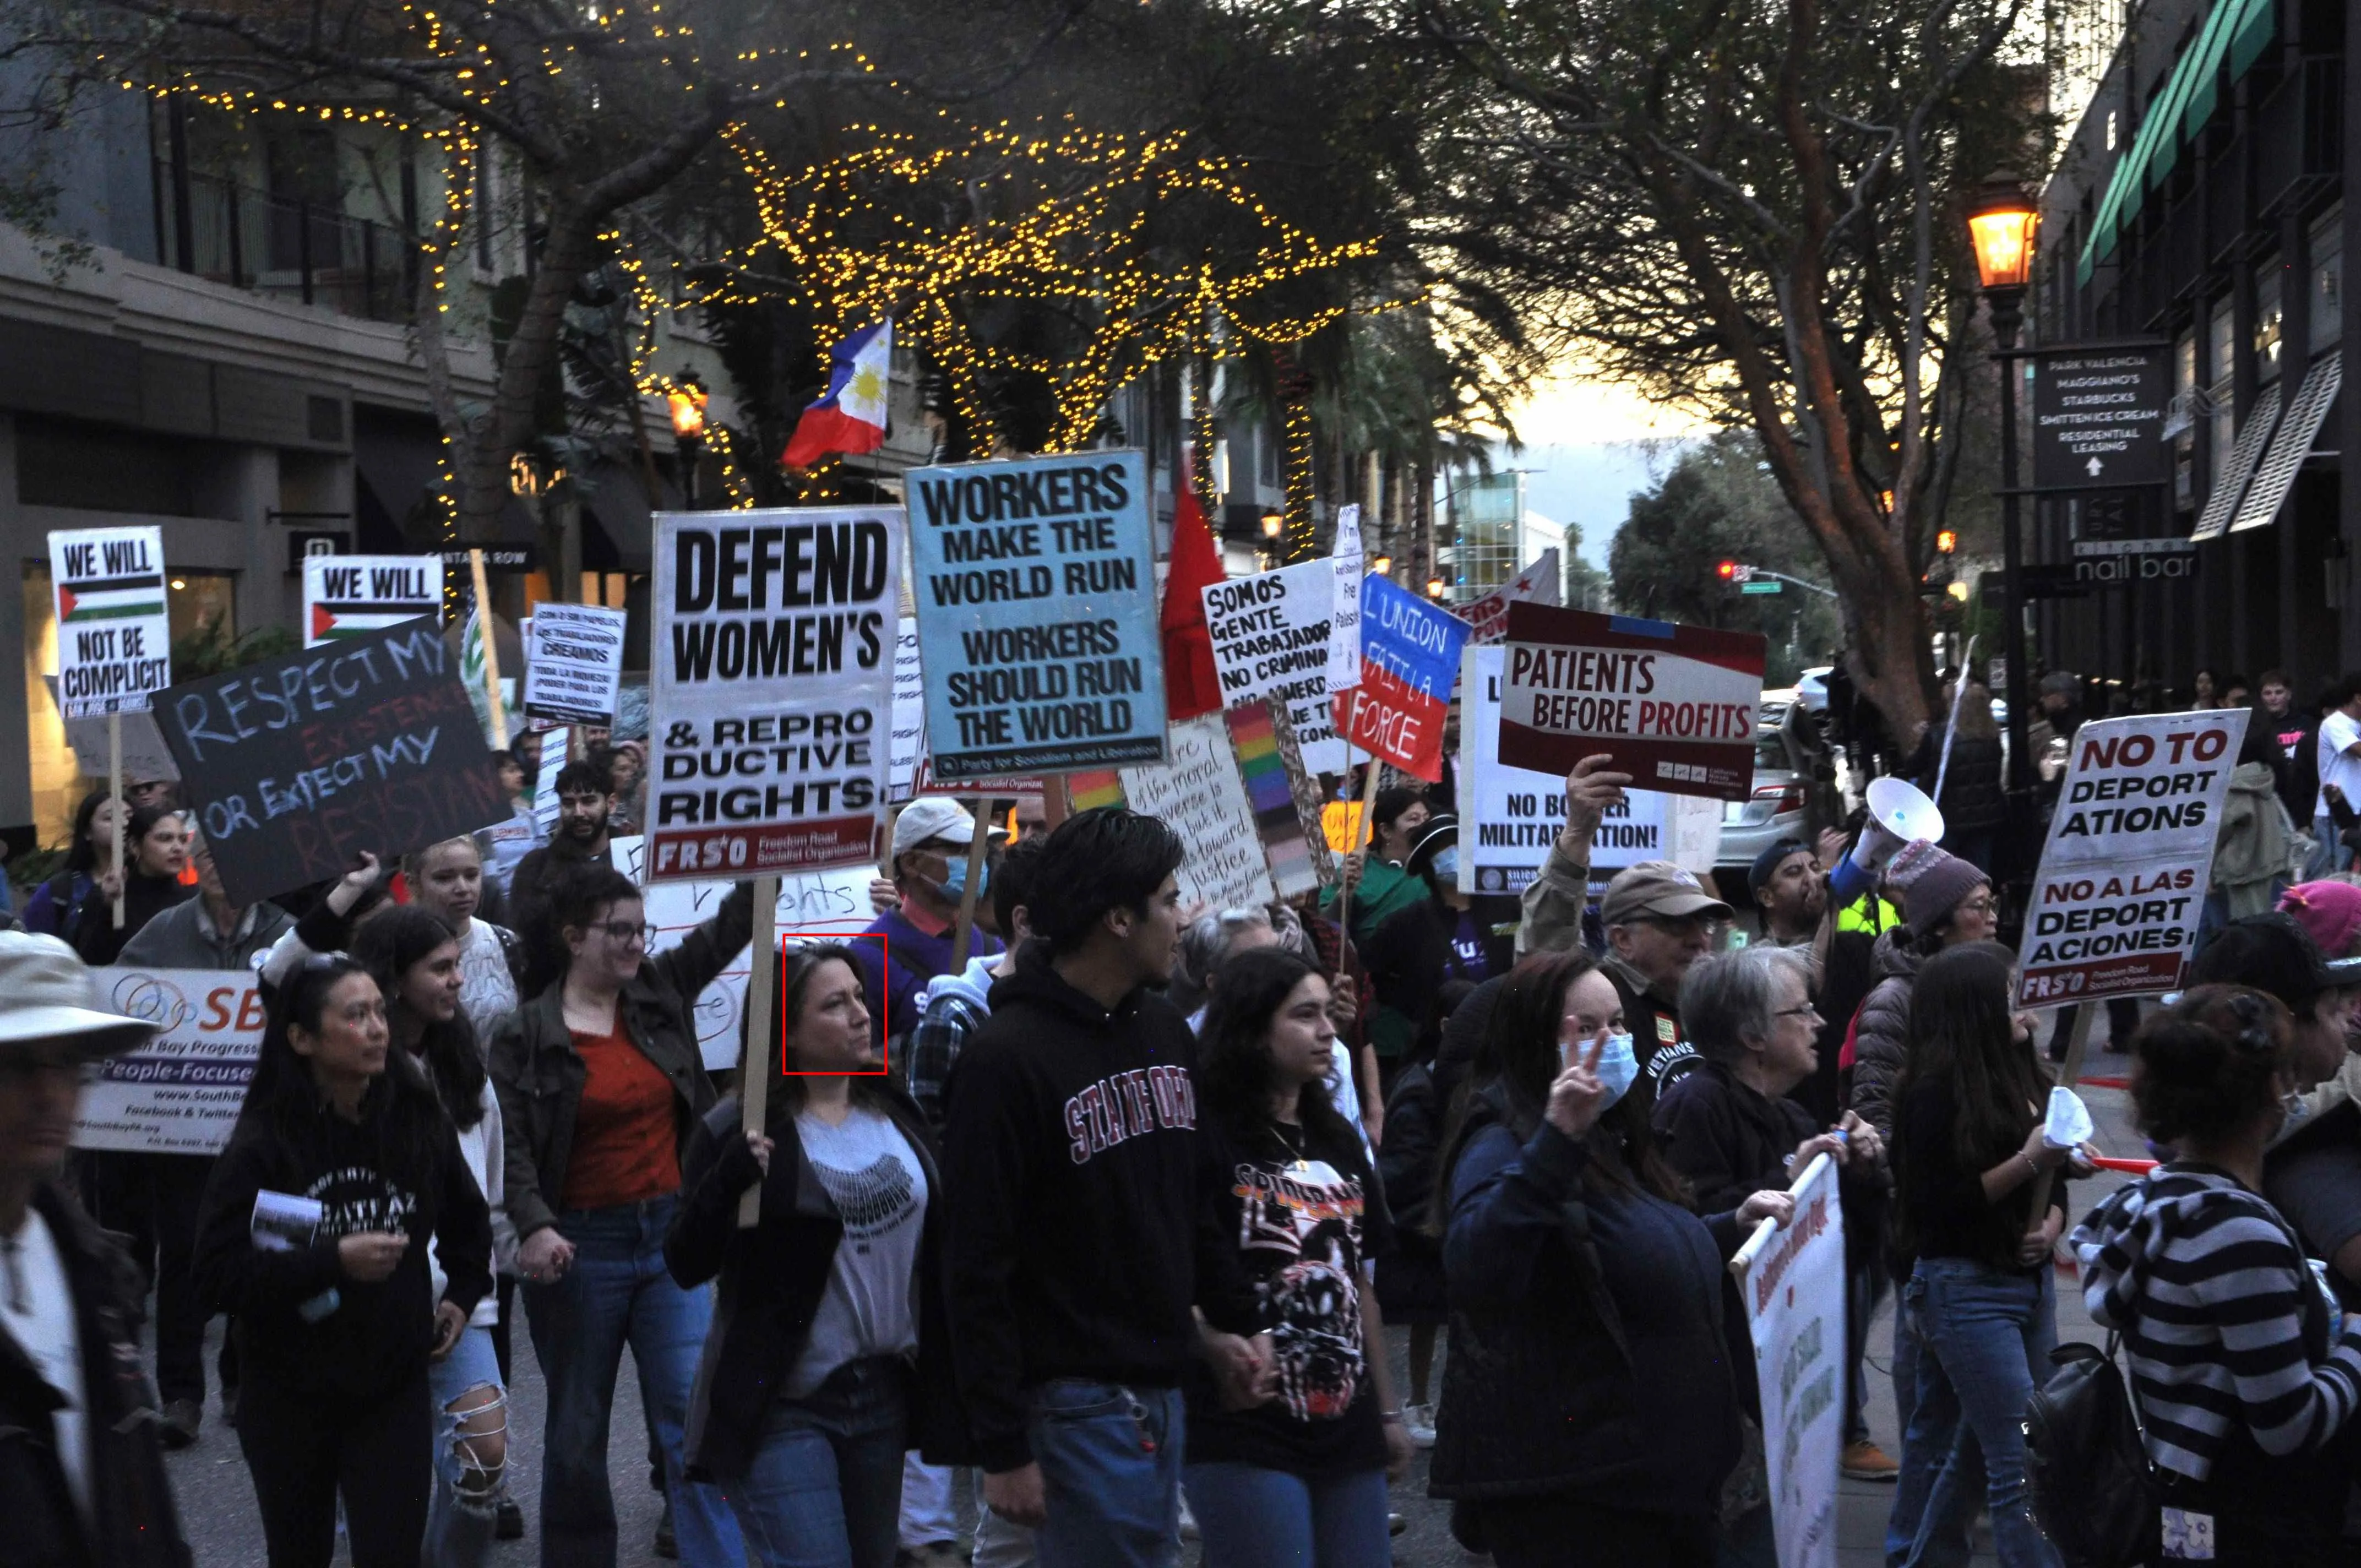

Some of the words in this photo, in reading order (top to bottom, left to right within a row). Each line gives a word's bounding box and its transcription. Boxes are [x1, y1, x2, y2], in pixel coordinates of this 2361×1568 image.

[2048, 360, 2083, 371] PARK
[2083, 356, 2147, 369] VALENCIA
[2057, 374, 2141, 389] MAGGIANO'S
[2039, 413, 2092, 426] SMITTEN
[2093, 412, 2114, 422] ICE
[2115, 410, 2160, 421] CREAM
[2061, 392, 2136, 406] STARBUCKS
[2058, 427, 2141, 442] RESIDENTIAL
[2071, 441, 2128, 454] LEASING
[919, 463, 1130, 527] WORKERS
[63, 542, 97, 578] WE
[102, 538, 153, 575] WILL
[426, 551, 490, 564] NTAA
[493, 551, 527, 565] ROW
[942, 524, 1042, 564] MAKE
[1050, 517, 1117, 553] THE
[323, 567, 363, 599] WE
[371, 567, 431, 599] WILL
[675, 520, 888, 613] DEFEND
[930, 565, 1052, 607] WORLD
[1064, 557, 1137, 596] RUN
[2075, 554, 2130, 581] nail
[2139, 553, 2194, 579] bar
[1206, 575, 1286, 619] SOMOS
[961, 618, 1121, 666] WORKERS
[1211, 606, 1290, 641] GENTE
[1216, 619, 1331, 664] TRABAJADOR
[77, 628, 117, 663] NOT
[122, 625, 146, 658] BE
[672, 611, 884, 683] WOMEN'S
[64, 658, 167, 698] COMPLICIT
[948, 663, 1069, 708] SHOULD
[1075, 656, 1143, 698] RUN
[1221, 667, 1251, 692] NO
[1255, 648, 1328, 682] CRIMINA
[1362, 641, 1410, 699] FAIT
[1511, 647, 1656, 694] PATIENTS
[174, 646, 383, 764] RESPECT
[385, 630, 447, 682] MY
[1532, 694, 1631, 734] BEFORE
[1638, 701, 1751, 739] PROFITS
[664, 720, 701, 749] &
[714, 709, 874, 747] REPRO
[955, 710, 1012, 748] THE
[1018, 698, 1133, 743] WORLD
[1350, 690, 1422, 761] FORCE
[662, 740, 872, 782] DUCTIVE
[2079, 733, 2156, 773] NO
[2166, 728, 2228, 766] TO
[204, 795, 258, 841] OR
[371, 725, 440, 780] MY
[659, 777, 875, 827] RIGHTS
[1009, 777, 1044, 791] Organizat
[2069, 770, 2217, 804] DEPORT
[1507, 793, 1537, 818] NO
[1545, 794, 1631, 818] BOER
[2058, 800, 2207, 838] ATIONS
[657, 835, 747, 872] FRSO
[759, 834, 808, 851] Freedom
[809, 829, 838, 846] Road
[757, 847, 803, 866] Socialist
[1479, 824, 1658, 849] MILITARATION!
[1507, 869, 1537, 881] SILICO
[2043, 879, 2093, 905] NO
[2099, 877, 2124, 900] A
[2129, 868, 2195, 896] LAS
[2035, 896, 2191, 937] DEPORT
[2022, 971, 2085, 1000] FRSO
[198, 986, 269, 1033] SB
[157, 1040, 190, 1057] Bay
[191, 1040, 259, 1057] Progress
[100, 1058, 255, 1083] People-Focuse
[124, 1104, 183, 1118] Facebook
[153, 1089, 247, 1103] www.SouthB
